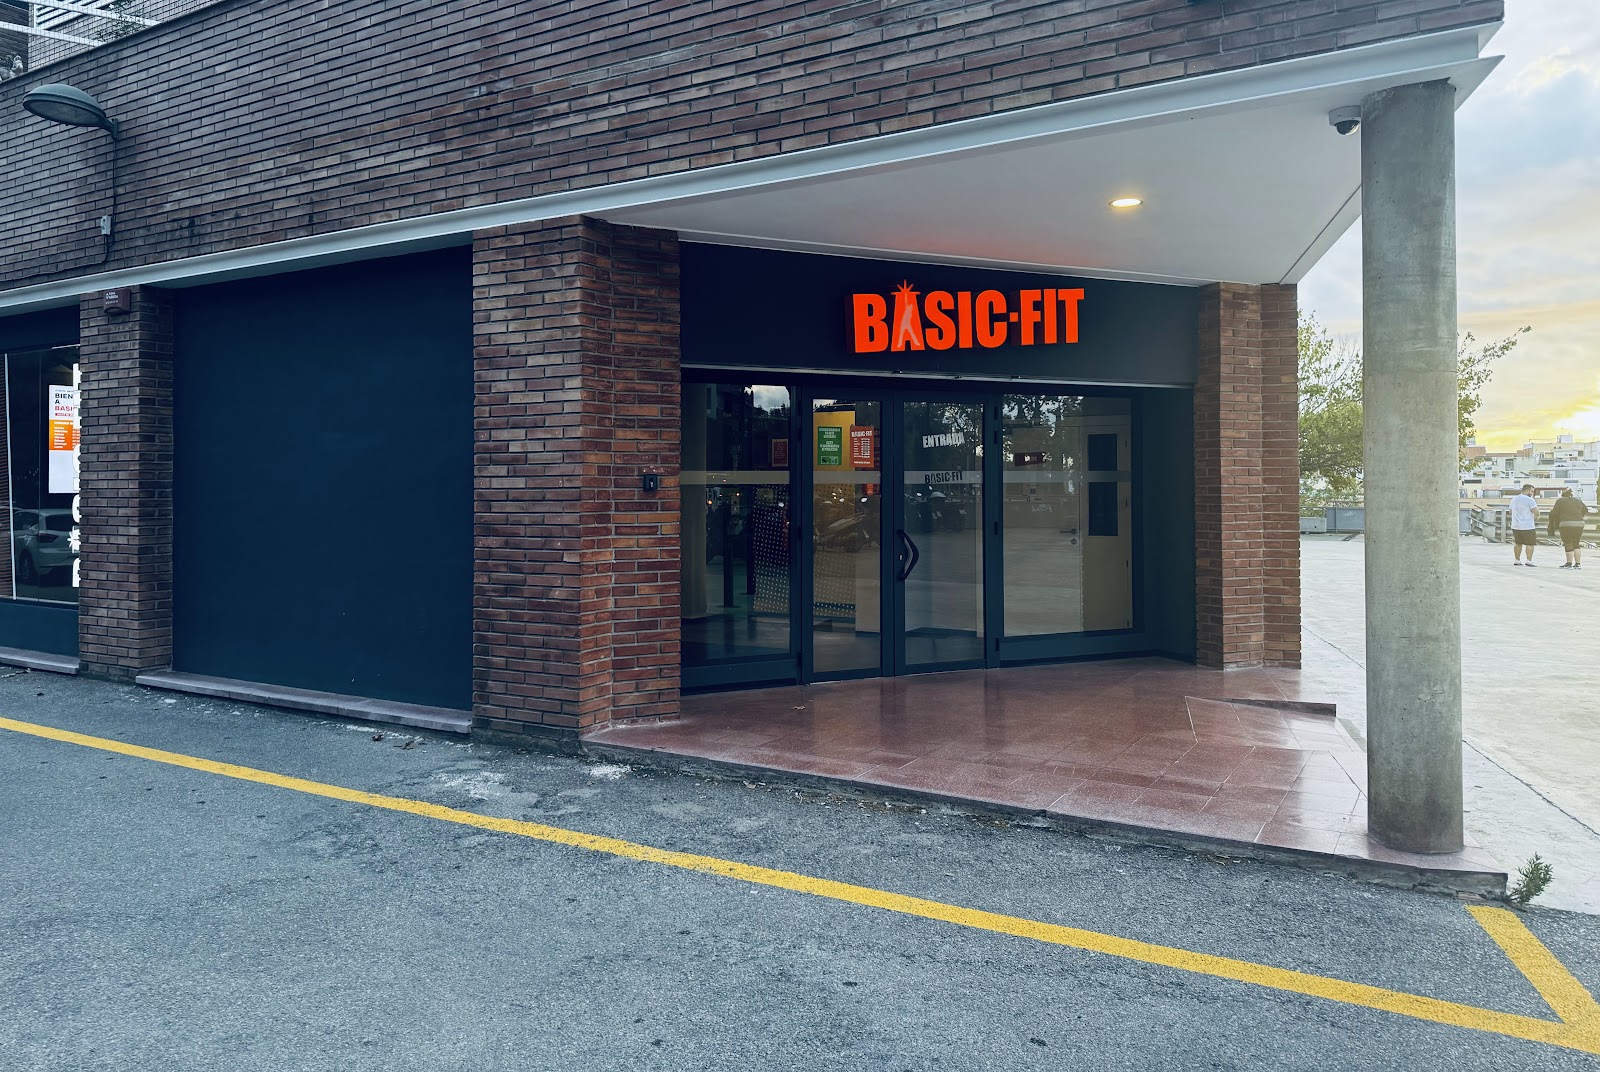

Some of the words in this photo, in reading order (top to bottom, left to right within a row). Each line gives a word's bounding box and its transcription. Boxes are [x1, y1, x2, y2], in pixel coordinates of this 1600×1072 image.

[853, 280, 1085, 353] BASIC-FIT
[922, 431, 966, 449] ENTRADA
[924, 470, 964, 484] BASIC-FIT
